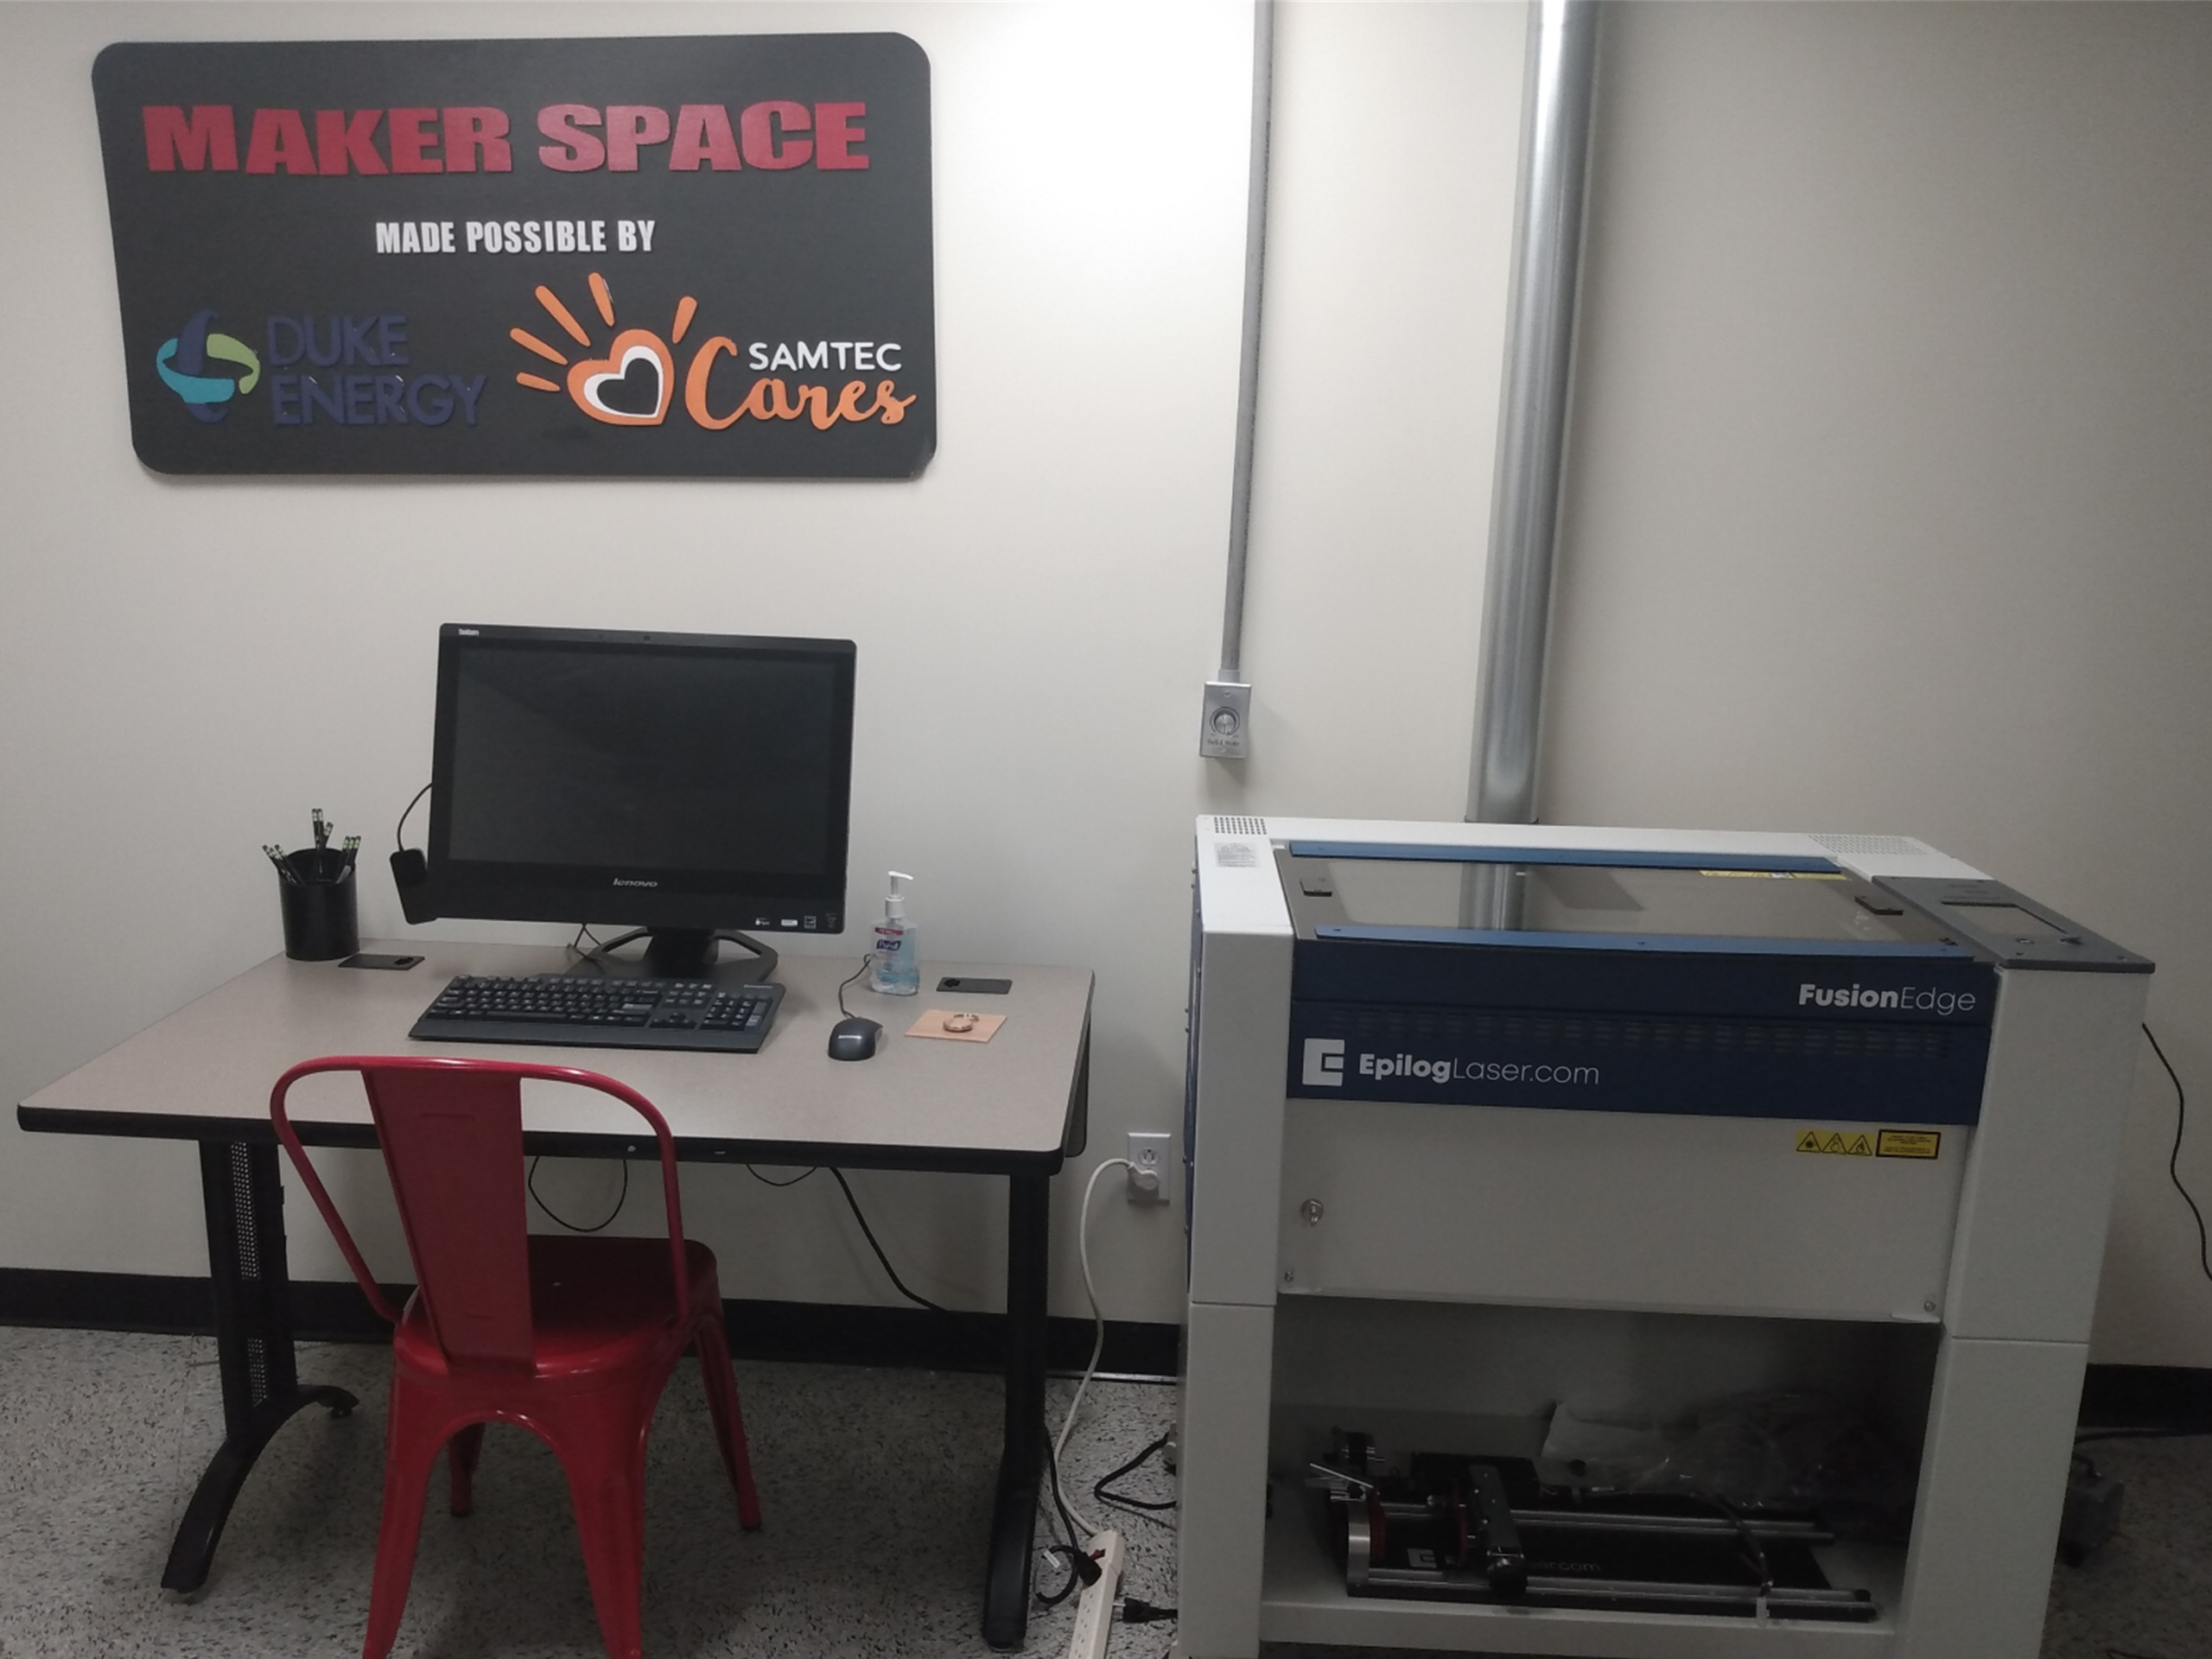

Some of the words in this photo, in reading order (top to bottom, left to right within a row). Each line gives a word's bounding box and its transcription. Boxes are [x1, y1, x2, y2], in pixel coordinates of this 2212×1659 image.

[142, 105, 513, 175] MAKER
[537, 100, 870, 173] SPACE
[376, 221, 456, 253] MADE
[466, 219, 607, 253] POSSIBLE
[618, 219, 655, 251] BY
[267, 315, 410, 366] DUKE
[748, 340, 902, 372] SAMTEC
[270, 372, 487, 426] ENERGY
[684, 335, 917, 430] Cares
[613, 878, 658, 887] lenovo
[1798, 983, 1976, 1015] FusionEdge
[1359, 1052, 1599, 1084] EpilogLaser.com
